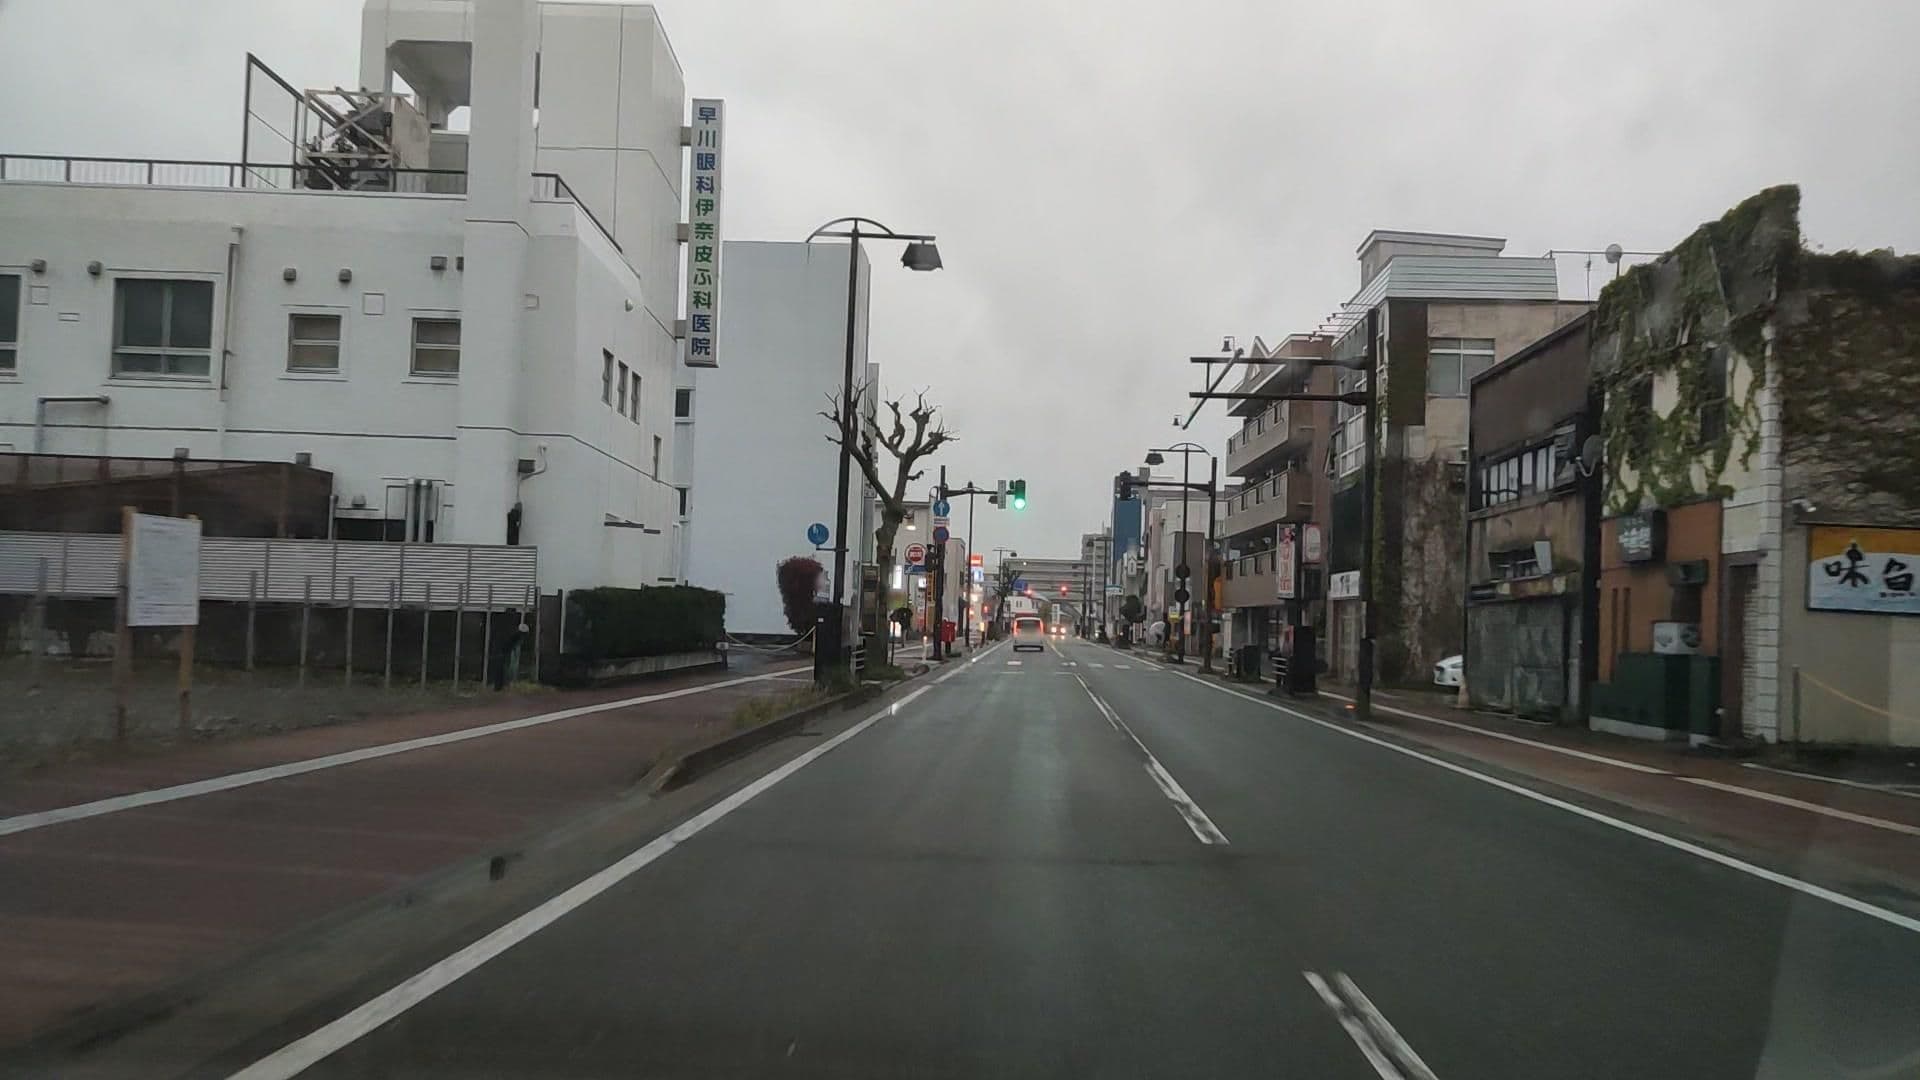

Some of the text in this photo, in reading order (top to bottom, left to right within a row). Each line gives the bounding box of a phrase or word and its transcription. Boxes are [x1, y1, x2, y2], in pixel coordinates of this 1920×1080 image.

[691, 106, 717, 356] 早川眼科伊奈皮ふ科医院
